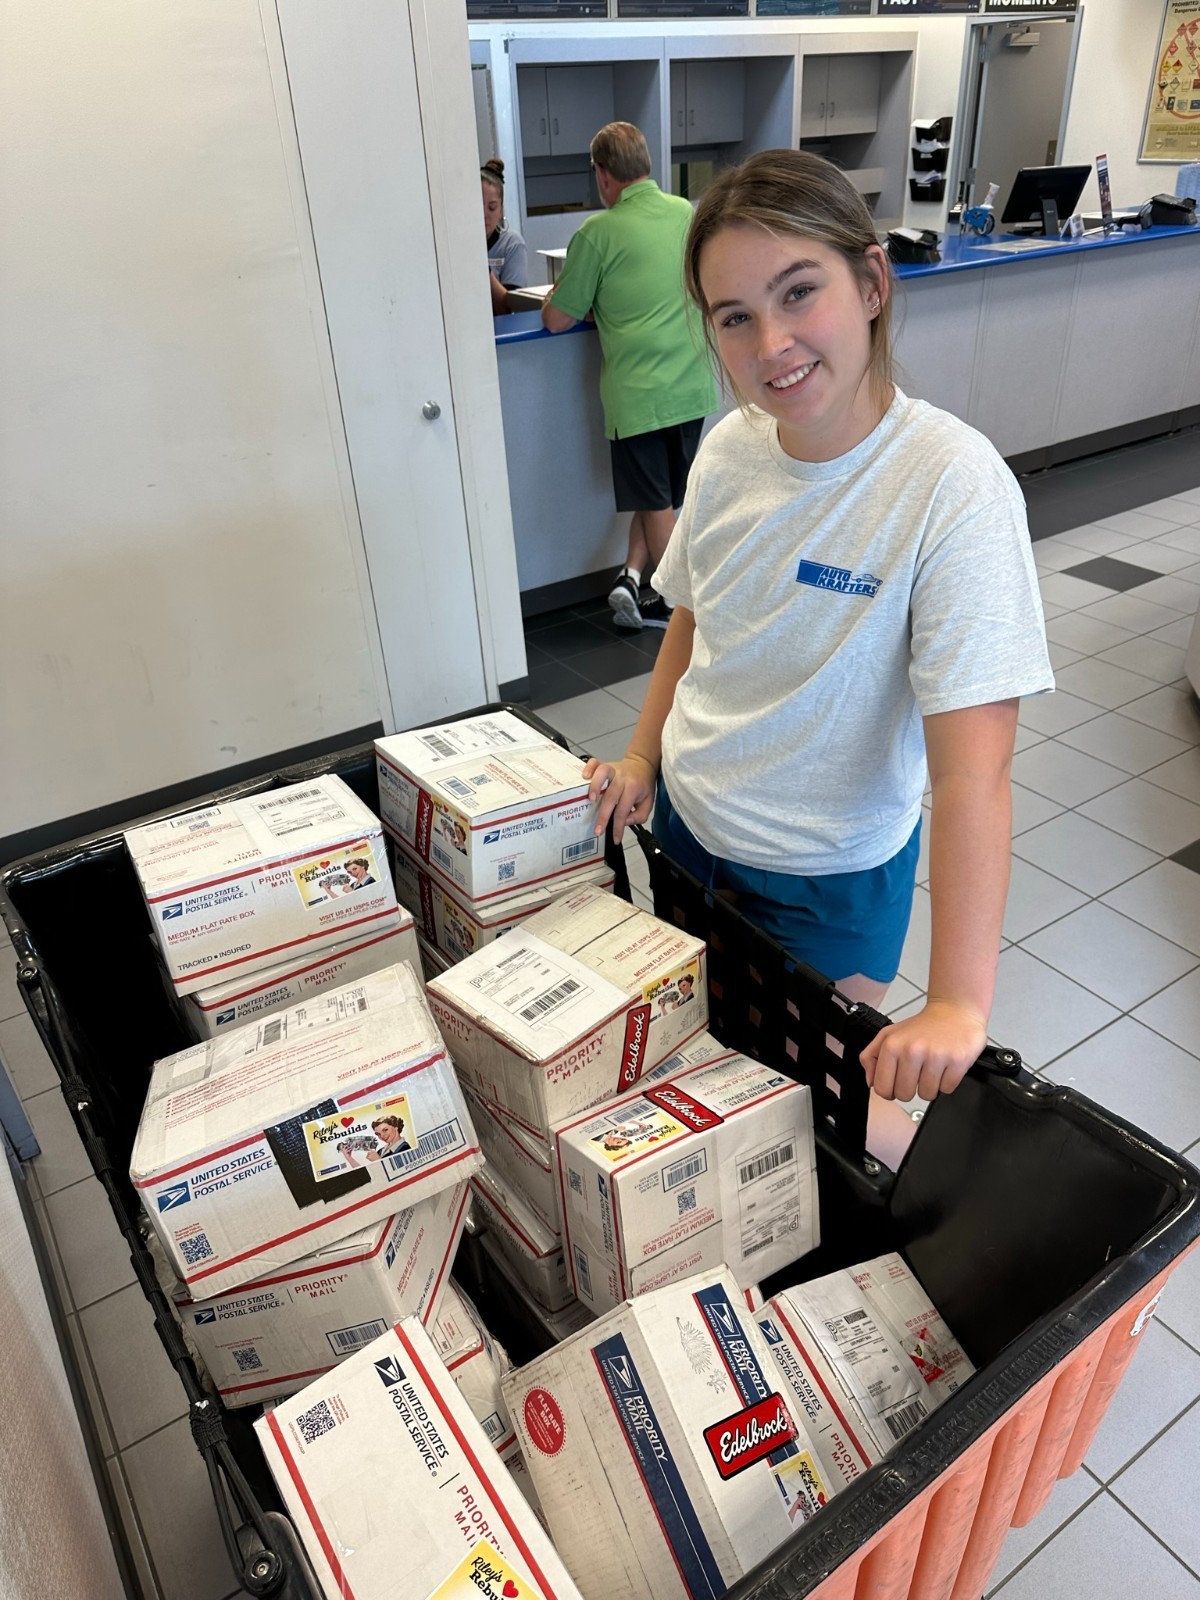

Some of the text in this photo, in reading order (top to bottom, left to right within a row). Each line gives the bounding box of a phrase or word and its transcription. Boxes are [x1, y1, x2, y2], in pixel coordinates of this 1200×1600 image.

[818, 577, 877, 595] KRAFTERS
[821, 568, 851, 582] AUTO
[558, 804, 590, 818] PRIORITY
[565, 813, 582, 822] MAIL
[500, 830, 522, 840] POSTAL
[502, 818, 544, 834] UNITED STATES
[259, 869, 292, 885] PRIORI
[271, 877, 294, 888] MAIL
[304, 865, 342, 883] Rebuilds
[185, 885, 240, 906] UNITED STATES
[186, 902, 213, 915] POSTAL
[318, 912, 334, 922] VISIT
[345, 906, 354, 914] AT
[167, 910, 256, 942] MEDIUM FLAT RATE BOX
[177, 943, 252, 971] TRACKED INSURED
[304, 963, 344, 984] PRIORITY
[315, 974, 336, 986] MAIL
[634, 962, 654, 977] MEDIUM
[238, 986, 288, 1010] UNITED STATES
[238, 1004, 264, 1018] POSTAL
[440, 1020, 462, 1039] MAIL
[546, 1034, 604, 1080] PRIORITY
[624, 1011, 645, 1082] Edelbrock
[562, 1057, 593, 1080] MAIL
[729, 1086, 772, 1107] UNITED STATES
[746, 1082, 768, 1094] POSTAL
[654, 1090, 712, 1127] Edelbrock
[313, 1120, 338, 1140] Riley's
[320, 1123, 368, 1144] Rebuilds
[634, 1124, 670, 1142] Rebuilds
[190, 1148, 266, 1186] UNITED STATES
[194, 1178, 232, 1199] POSTAL
[642, 1214, 715, 1256] MEDIUM FLAT RATE BOX
[690, 1256, 702, 1266] VISIT
[294, 1275, 344, 1294] PRIORITY
[396, 1265, 409, 1293] MEDIUM
[424, 1268, 435, 1294] INSURED
[216, 1292, 275, 1312] UNITED STATES
[310, 1286, 336, 1299] MAIL
[218, 1308, 248, 1320] POSTAL
[704, 1304, 717, 1328] UNITED
[714, 1327, 728, 1350] STATES
[724, 1350, 738, 1373] POSTAL
[727, 1340, 745, 1375] MAIL
[772, 1347, 794, 1380] POSTAL
[736, 1339, 768, 1399] PRIORITY
[781, 1344, 823, 1411] UNITED STATES
[602, 1360, 614, 1385] UNITED
[611, 1384, 622, 1408] STATES
[620, 1408, 632, 1432] POSTAL
[388, 1388, 418, 1428] POSTAL
[538, 1393, 550, 1413] FLAT
[548, 1412, 562, 1436] RATE
[540, 1410, 552, 1428] BOX
[624, 1398, 644, 1435] MAIL
[401, 1382, 450, 1460] UNITED STATES
[634, 1395, 668, 1462] PRIORITY
[720, 1406, 788, 1463] Edelbrock
[830, 1432, 860, 1480] PRIORI
[800, 1461, 818, 1490] Riley's
[832, 1451, 851, 1484] MAIL
[799, 1468, 821, 1512] Rebuil
[471, 1556, 503, 1583] Riley's
[469, 1568, 504, 1600] Rebu
